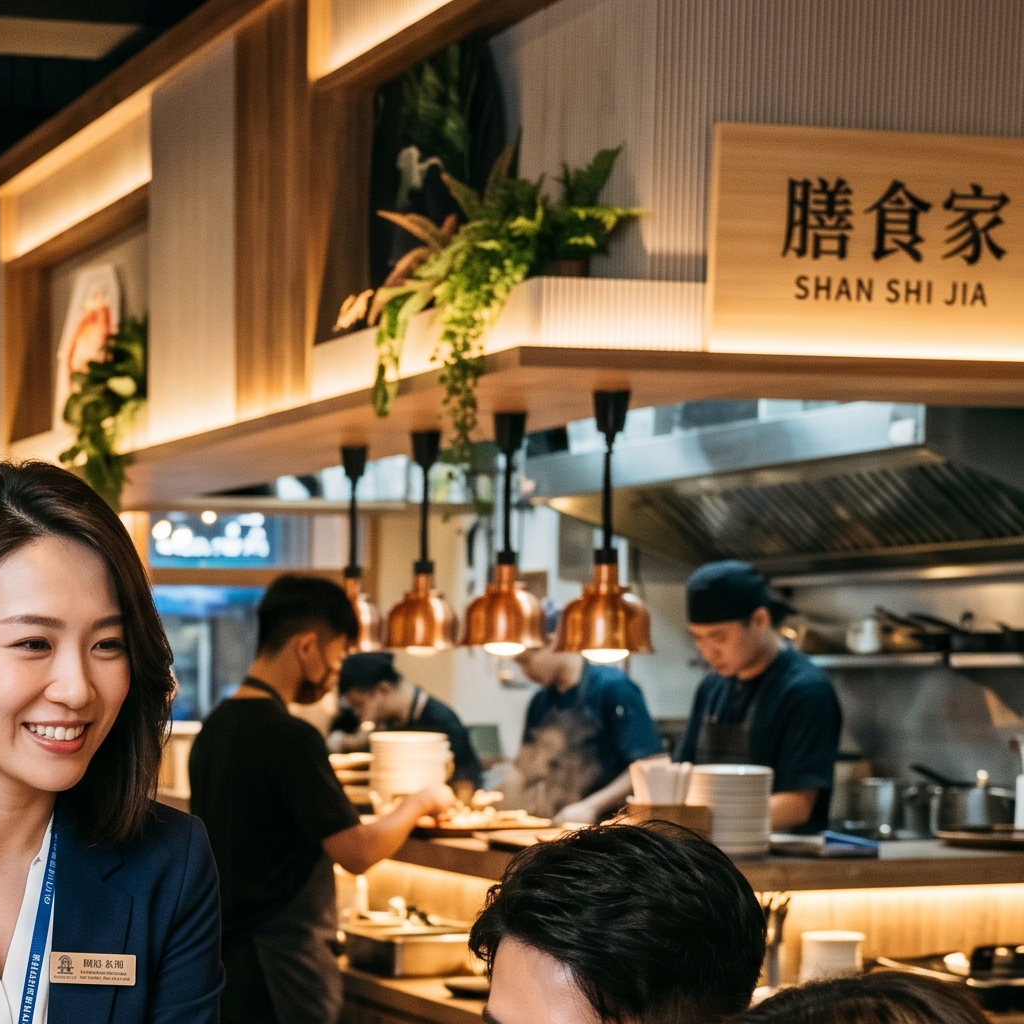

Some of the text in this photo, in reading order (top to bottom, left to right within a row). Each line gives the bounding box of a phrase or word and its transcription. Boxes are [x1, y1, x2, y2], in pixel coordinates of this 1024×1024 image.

[781, 177, 1010, 266] 膳食家
[794, 275, 988, 307] SHAN SHI JIA
